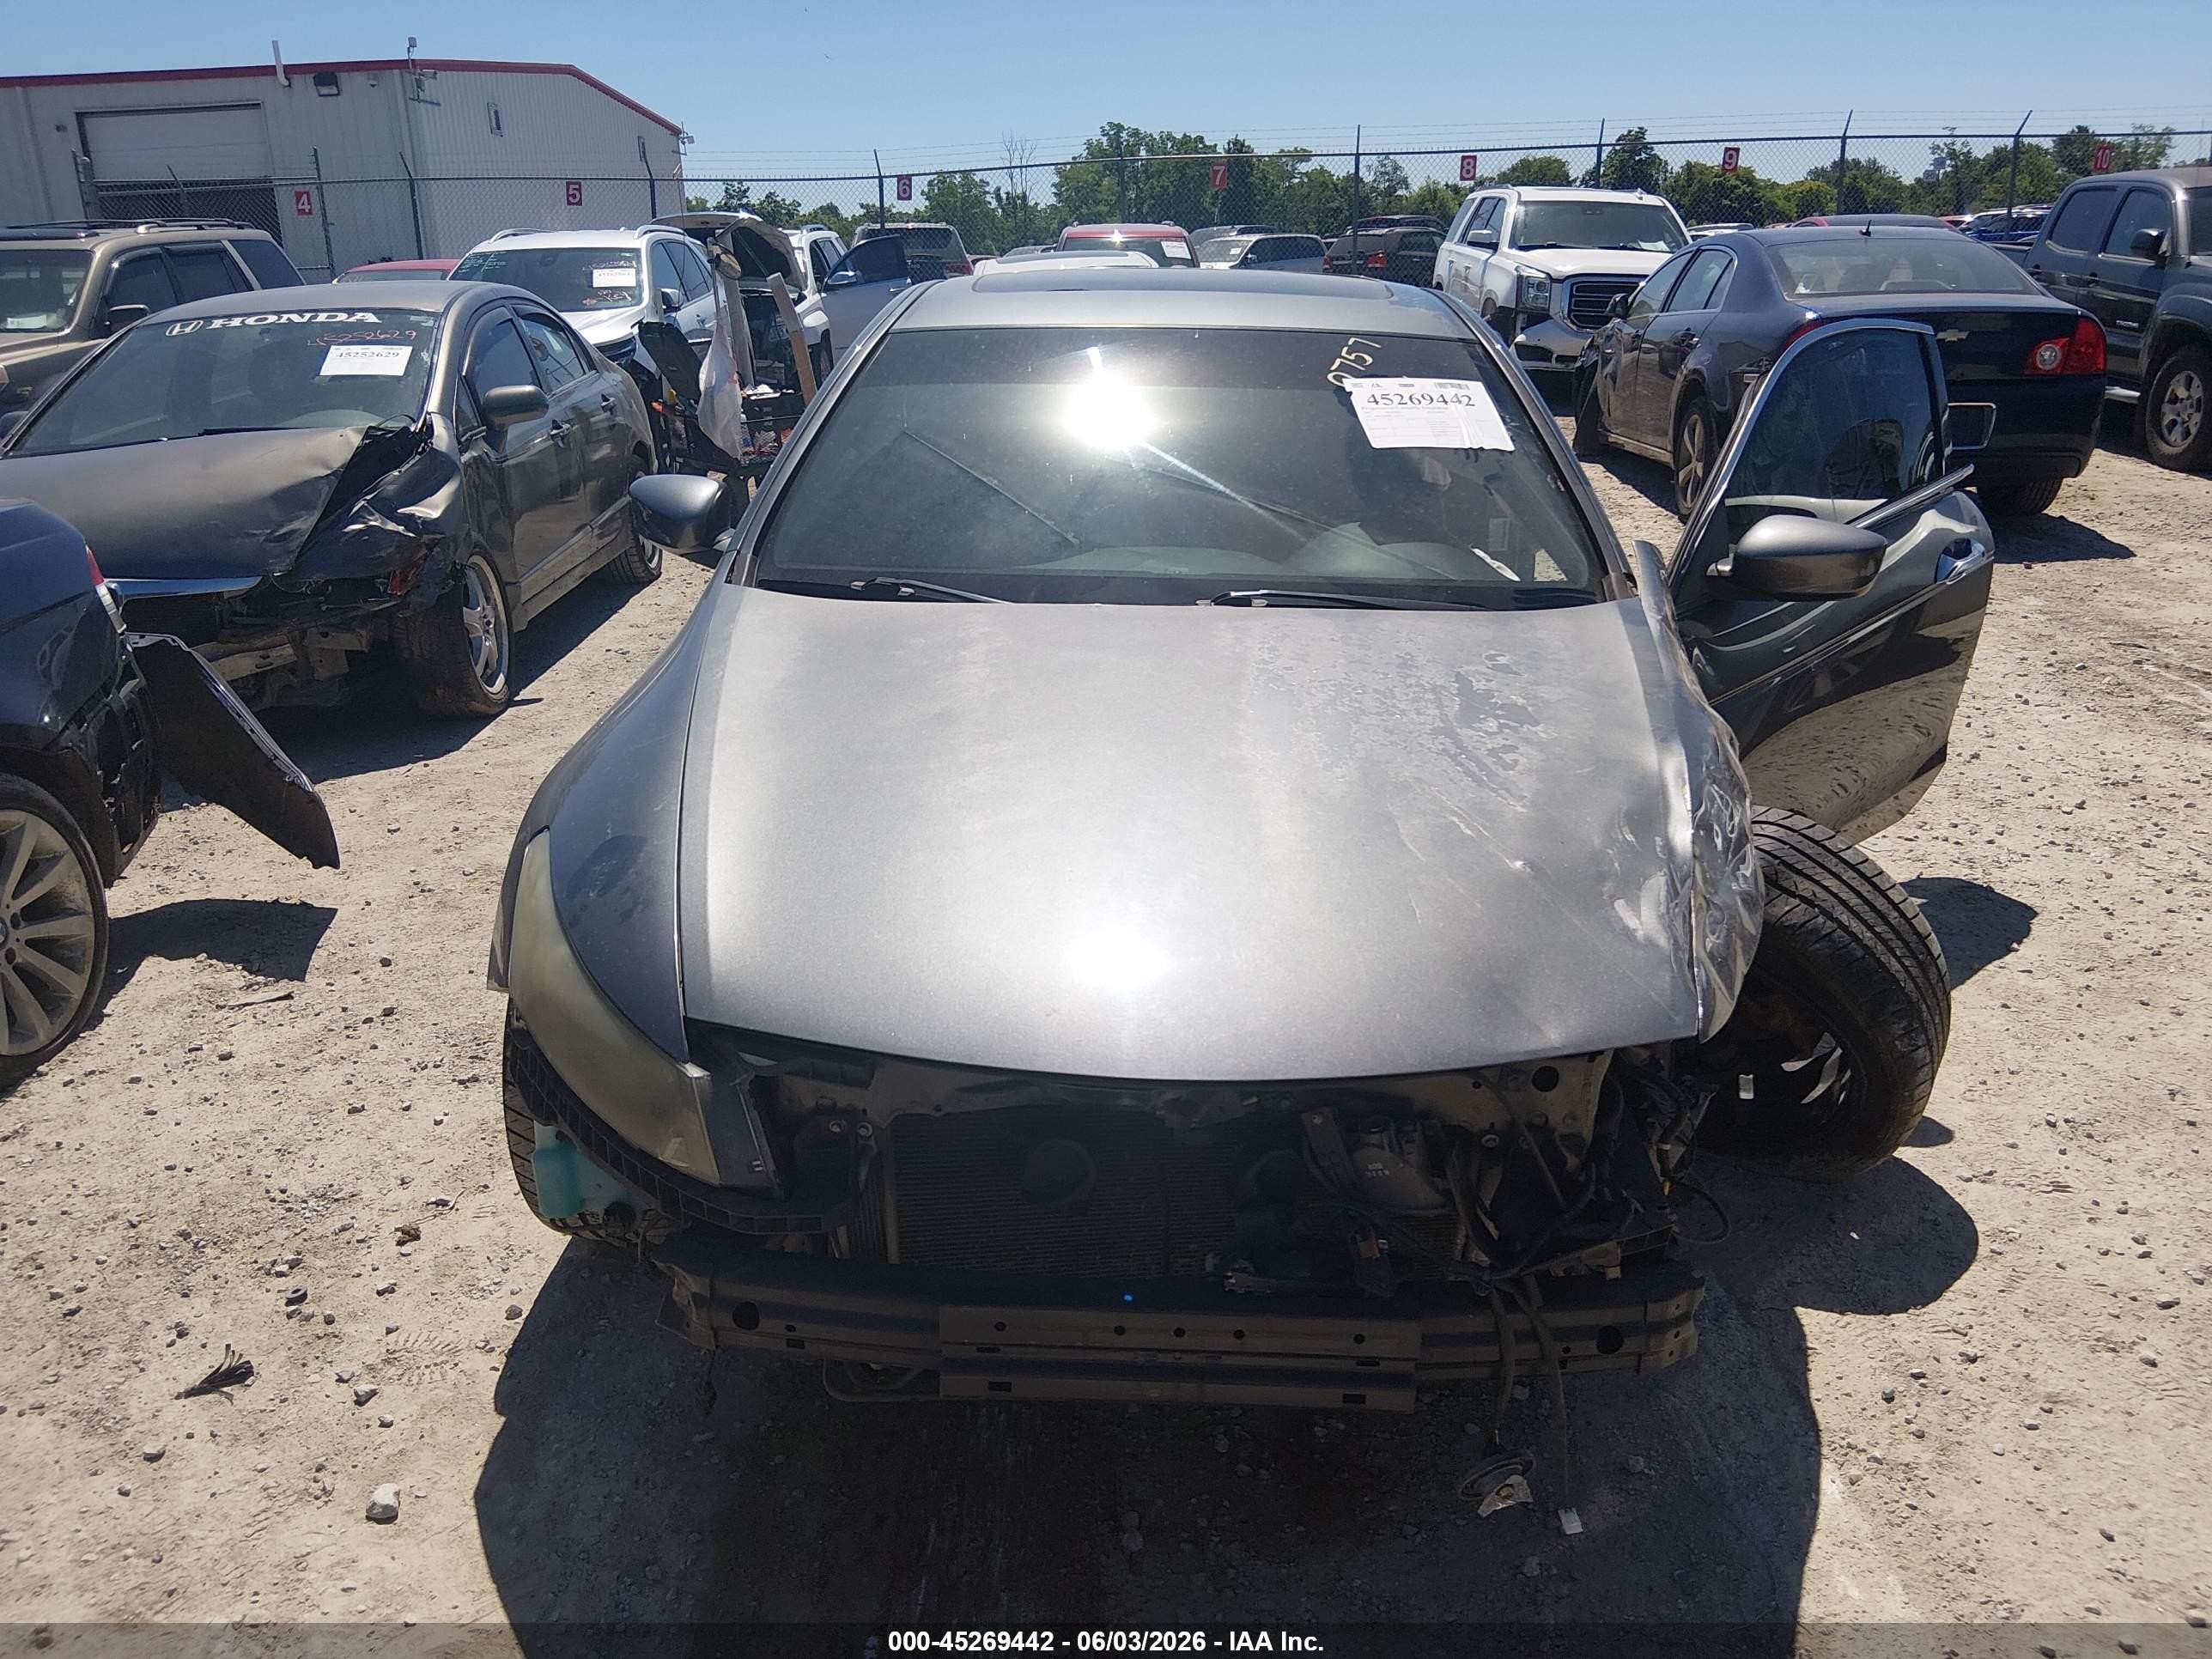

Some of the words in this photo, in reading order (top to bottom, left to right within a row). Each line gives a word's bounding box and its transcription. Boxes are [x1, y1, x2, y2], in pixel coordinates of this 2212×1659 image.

[1724, 150, 1737, 170] 9
[2097, 149, 2110, 169] 10
[1213, 166, 1225, 185] 7
[1462, 159, 1474, 179] 8
[568, 185, 580, 204] 5
[898, 179, 910, 198] 6
[298, 193, 310, 213] 4
[206, 313, 382, 330] HONDA
[1367, 392, 1475, 407] 45269442
